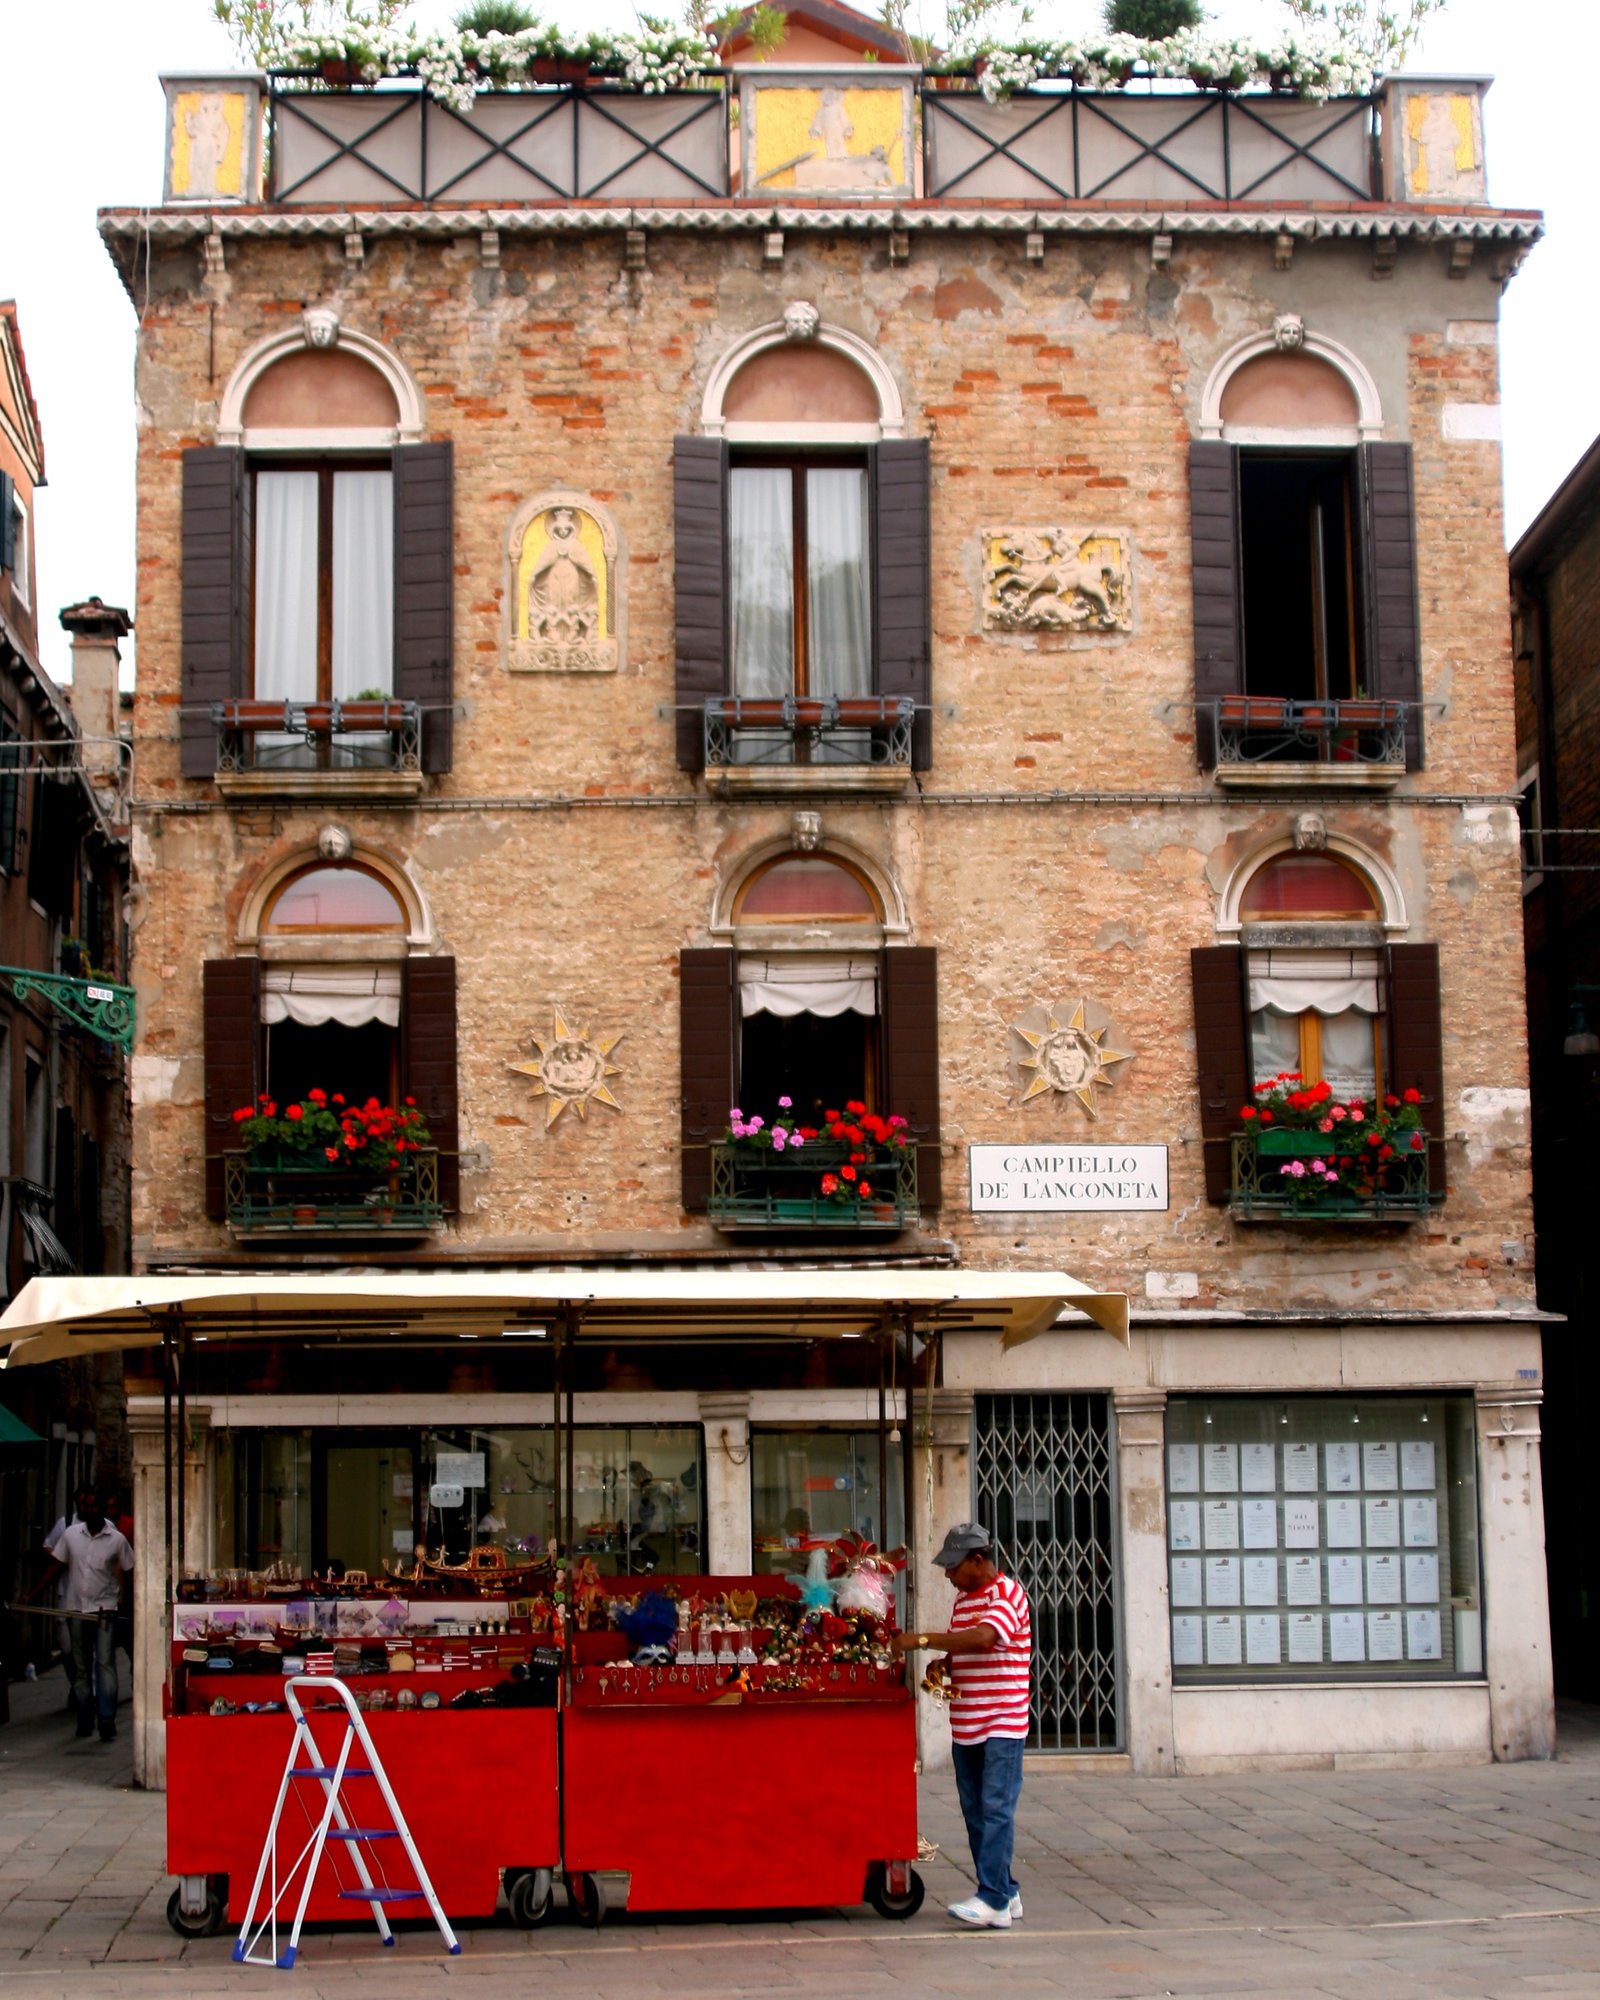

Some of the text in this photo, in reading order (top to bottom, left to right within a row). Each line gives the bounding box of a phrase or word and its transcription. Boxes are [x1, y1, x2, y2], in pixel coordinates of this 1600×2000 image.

[1003, 1157, 1137, 1174] CAMPIELLO
[979, 1178, 1159, 1199] DE L'ANCONETA
